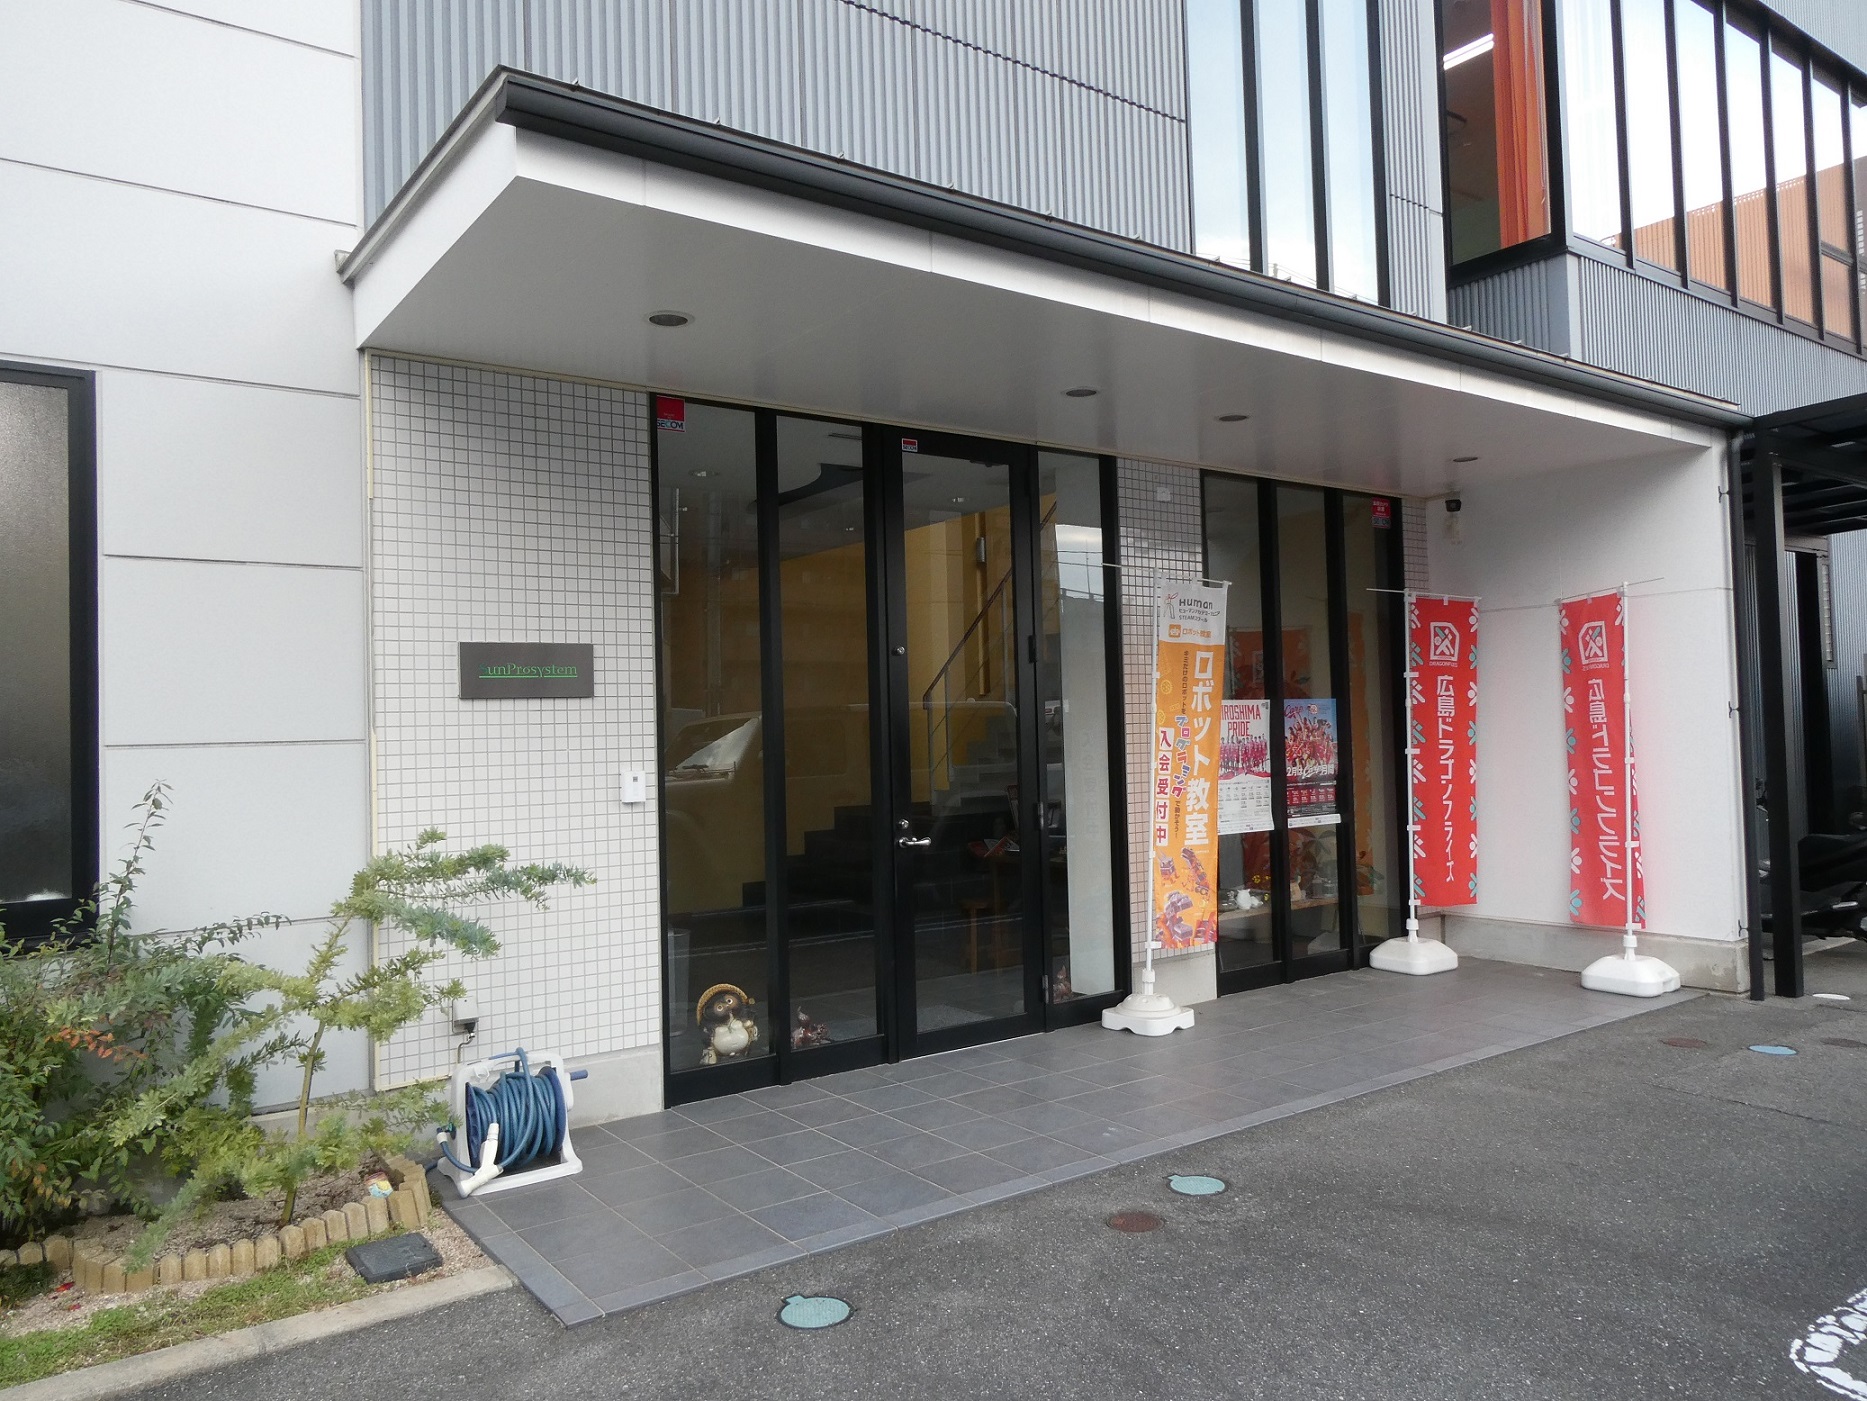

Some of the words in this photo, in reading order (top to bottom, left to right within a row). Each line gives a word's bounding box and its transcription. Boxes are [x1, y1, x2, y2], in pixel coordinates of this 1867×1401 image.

[656, 419, 684, 430] SECOM
[1179, 598, 1213, 610] Human
[479, 663, 577, 678] SunProsystem
[1221, 704, 1261, 721] IROSHIMA
[1227, 721, 1251, 737] PRIDE
[1185, 651, 1214, 845] ロボット教室
[1171, 715, 1191, 800] プログラミング
[1156, 729, 1172, 845] 入会受付中
[1436, 674, 1456, 883] 広島ドラゴンフライズ
